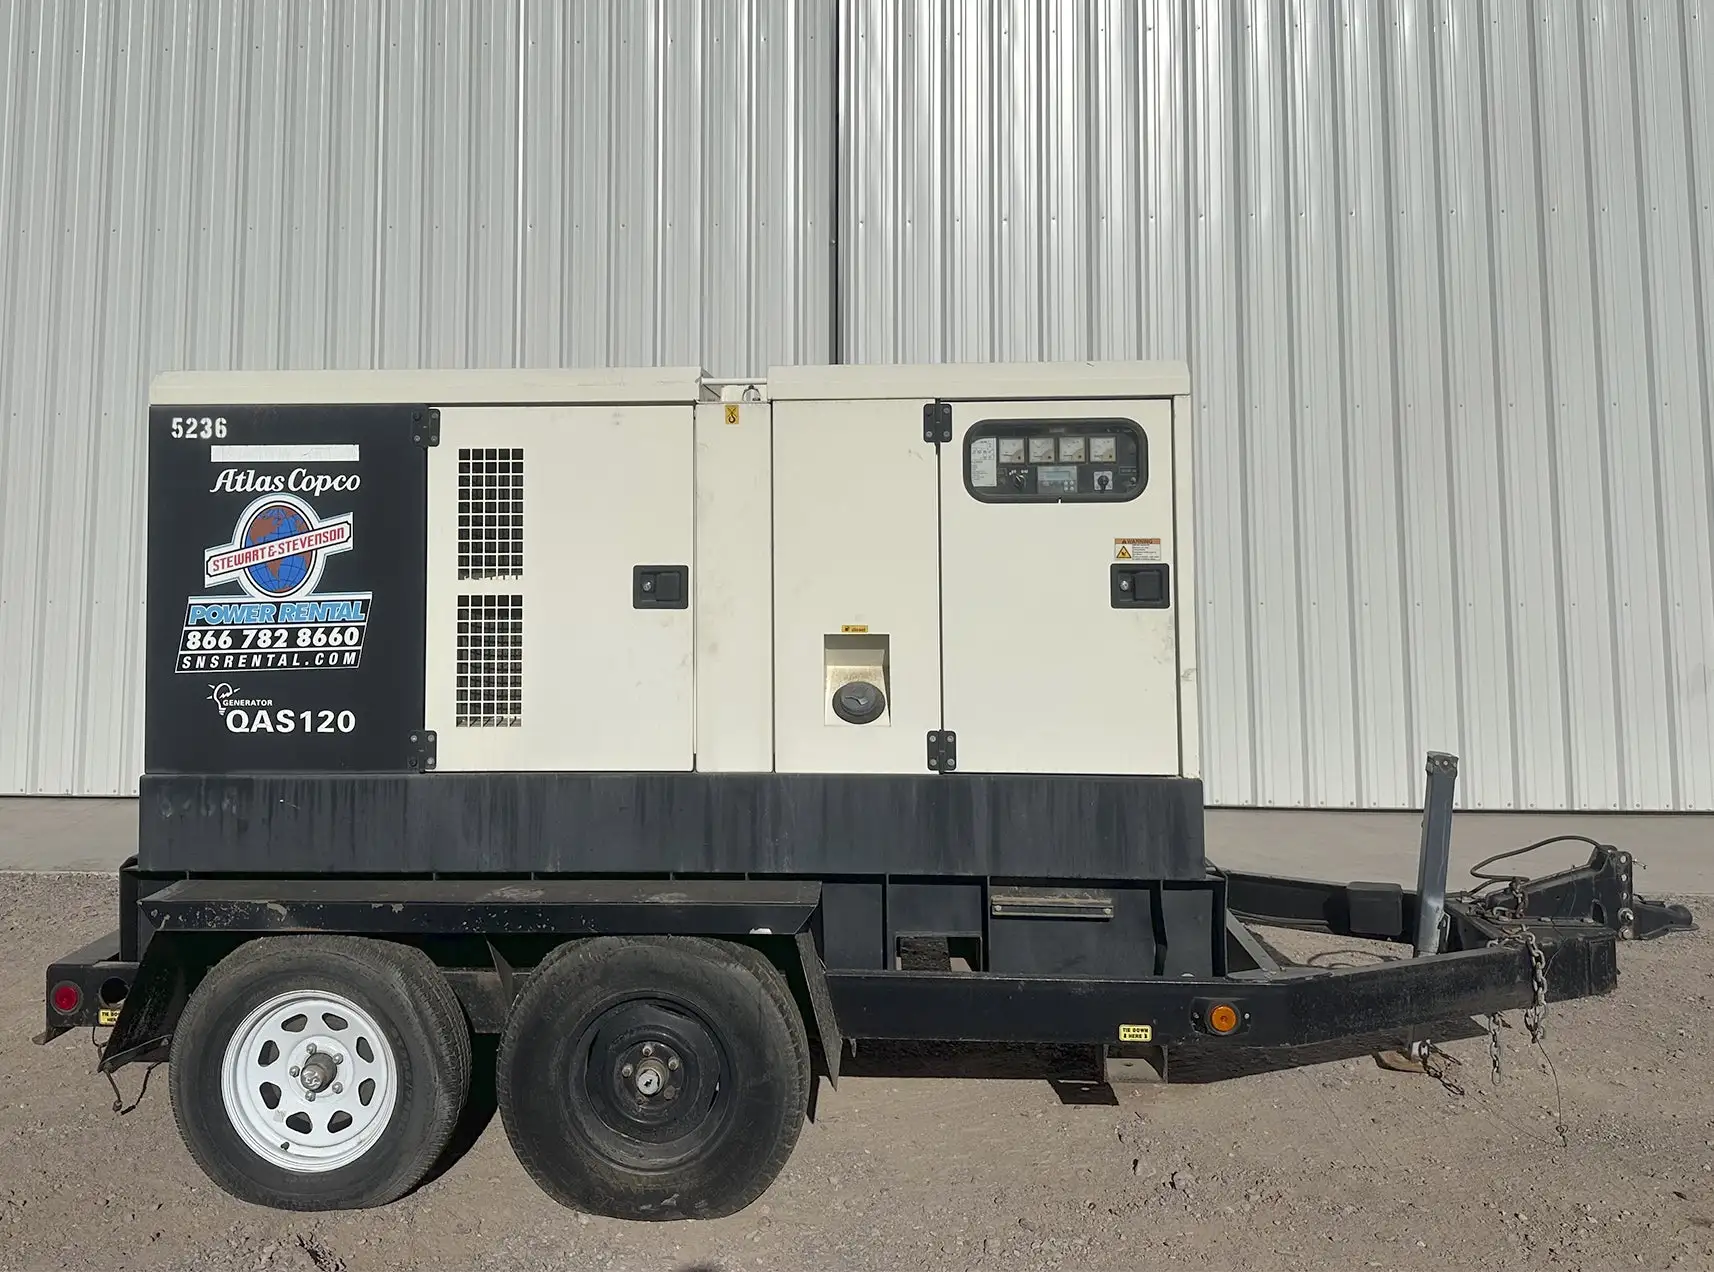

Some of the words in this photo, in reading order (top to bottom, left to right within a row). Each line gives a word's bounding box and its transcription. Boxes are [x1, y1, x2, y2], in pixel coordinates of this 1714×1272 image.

[171, 417, 228, 439] 5236
[209, 468, 285, 493] Atlas
[287, 468, 361, 496] Copco
[212, 546, 267, 572] STEWART
[268, 544, 277, 557] &
[278, 526, 345, 555] STEVENSON
[188, 604, 276, 625] POWER
[277, 600, 366, 623] RENTAL
[186, 630, 233, 650] 866
[240, 628, 289, 649] 782
[296, 626, 360, 648] 8660
[181, 651, 357, 669] SNSRENTAL.COM
[222, 699, 273, 707] GENERATOR
[226, 709, 356, 733] QAS120
